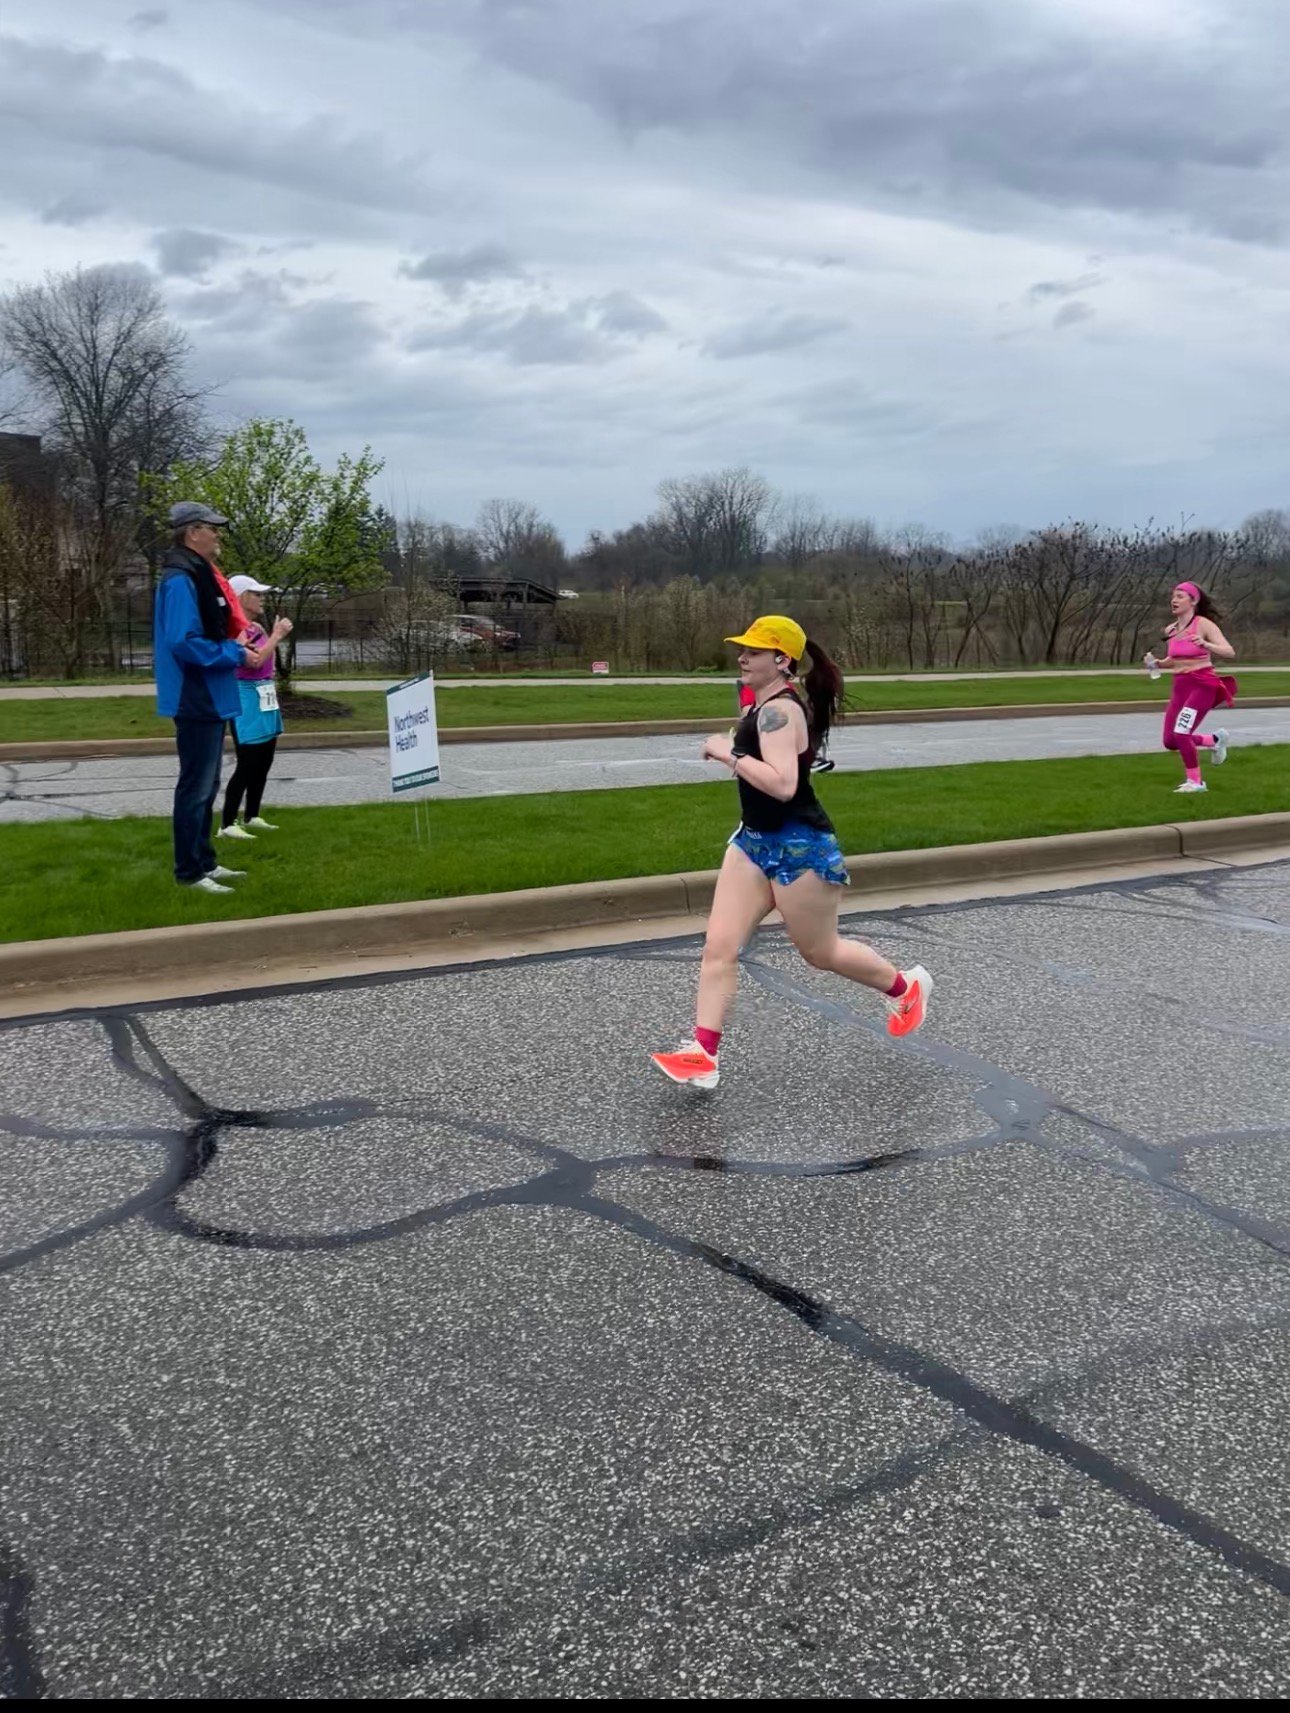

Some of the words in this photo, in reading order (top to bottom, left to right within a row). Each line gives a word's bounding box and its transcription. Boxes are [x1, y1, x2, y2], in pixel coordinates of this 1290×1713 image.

[394, 706, 429, 733] Northwest
[1177, 712, 1192, 729] 226
[395, 730, 418, 753] Health
